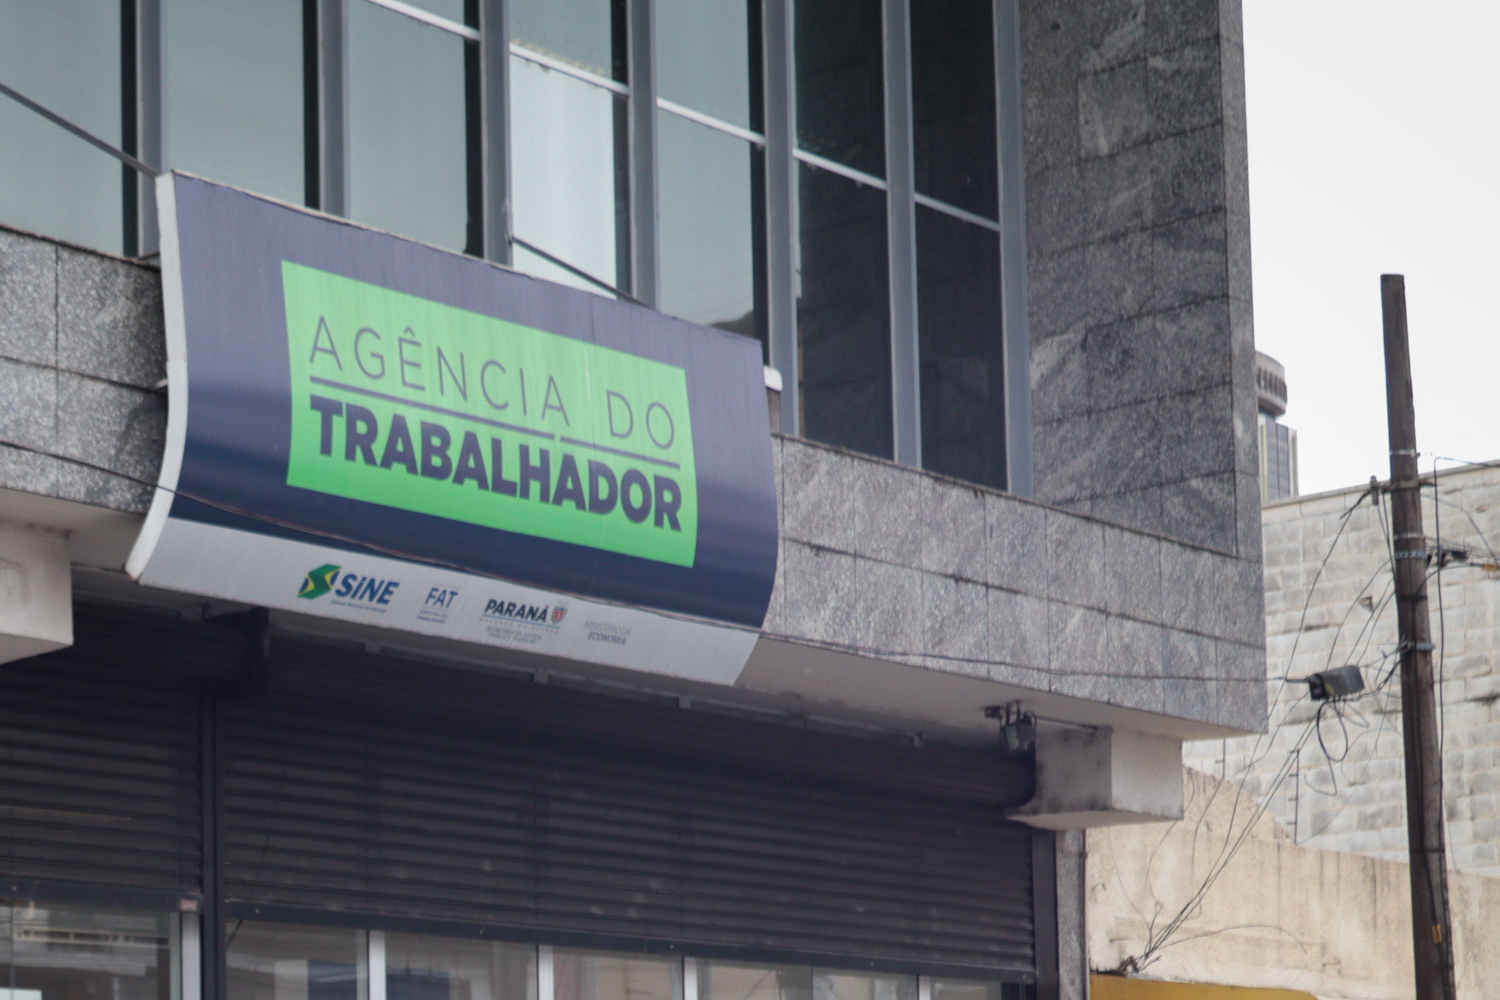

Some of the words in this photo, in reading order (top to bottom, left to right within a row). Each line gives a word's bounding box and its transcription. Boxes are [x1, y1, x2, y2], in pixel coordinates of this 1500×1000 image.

[309, 315, 570, 426] AGÊNCIA
[606, 390, 675, 450] DO
[310, 394, 682, 532] TRABALHADOR
[425, 586, 458, 609] FAT
[484, 598, 549, 623] PARANÁ
